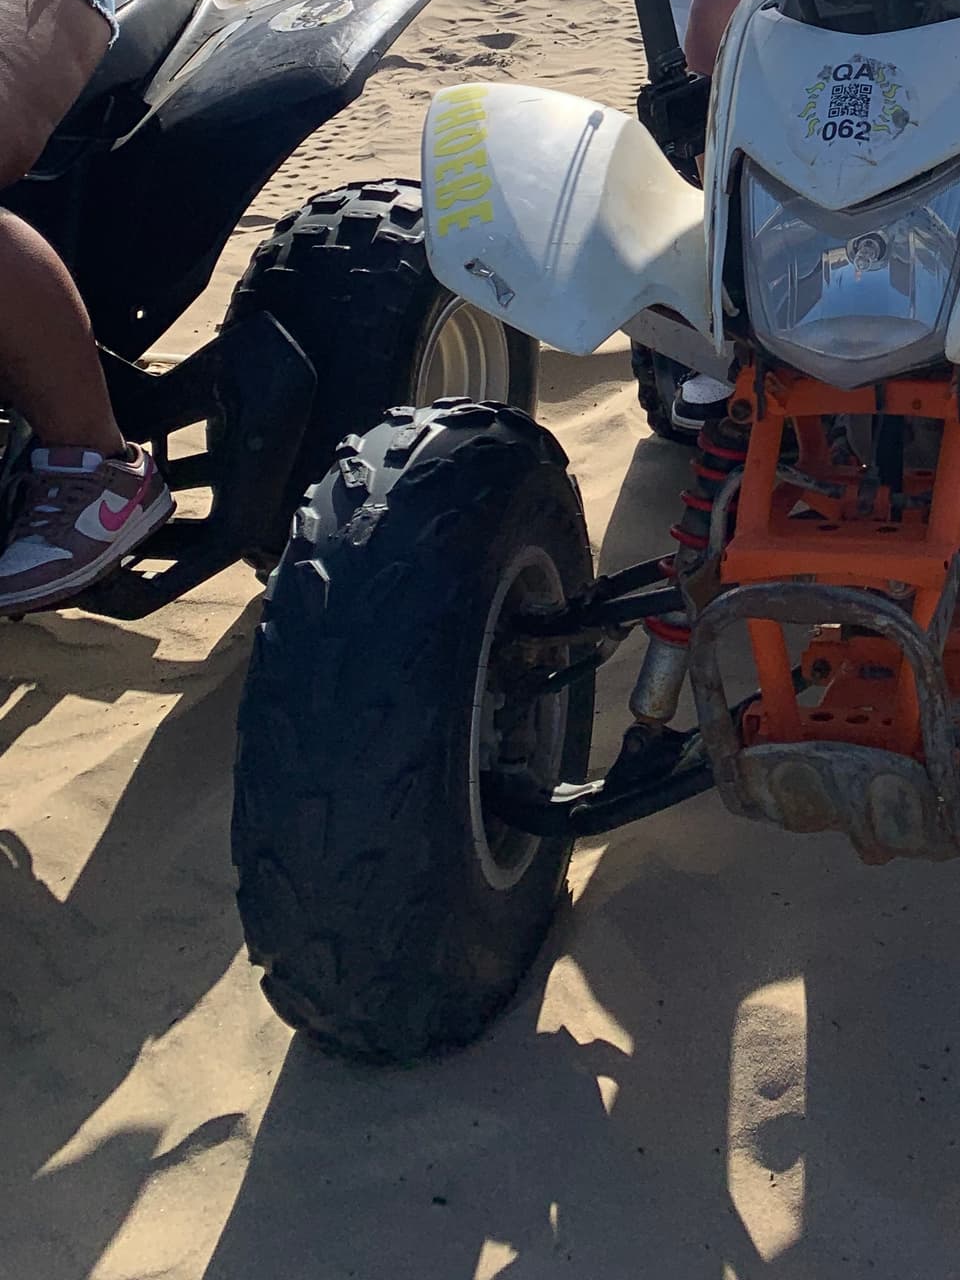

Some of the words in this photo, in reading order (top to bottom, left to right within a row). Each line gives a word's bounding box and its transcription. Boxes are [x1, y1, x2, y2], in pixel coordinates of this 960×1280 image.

[832, 63, 875, 82] QA
[822, 119, 872, 141] 062
[433, 87, 495, 238] PHOEBE
